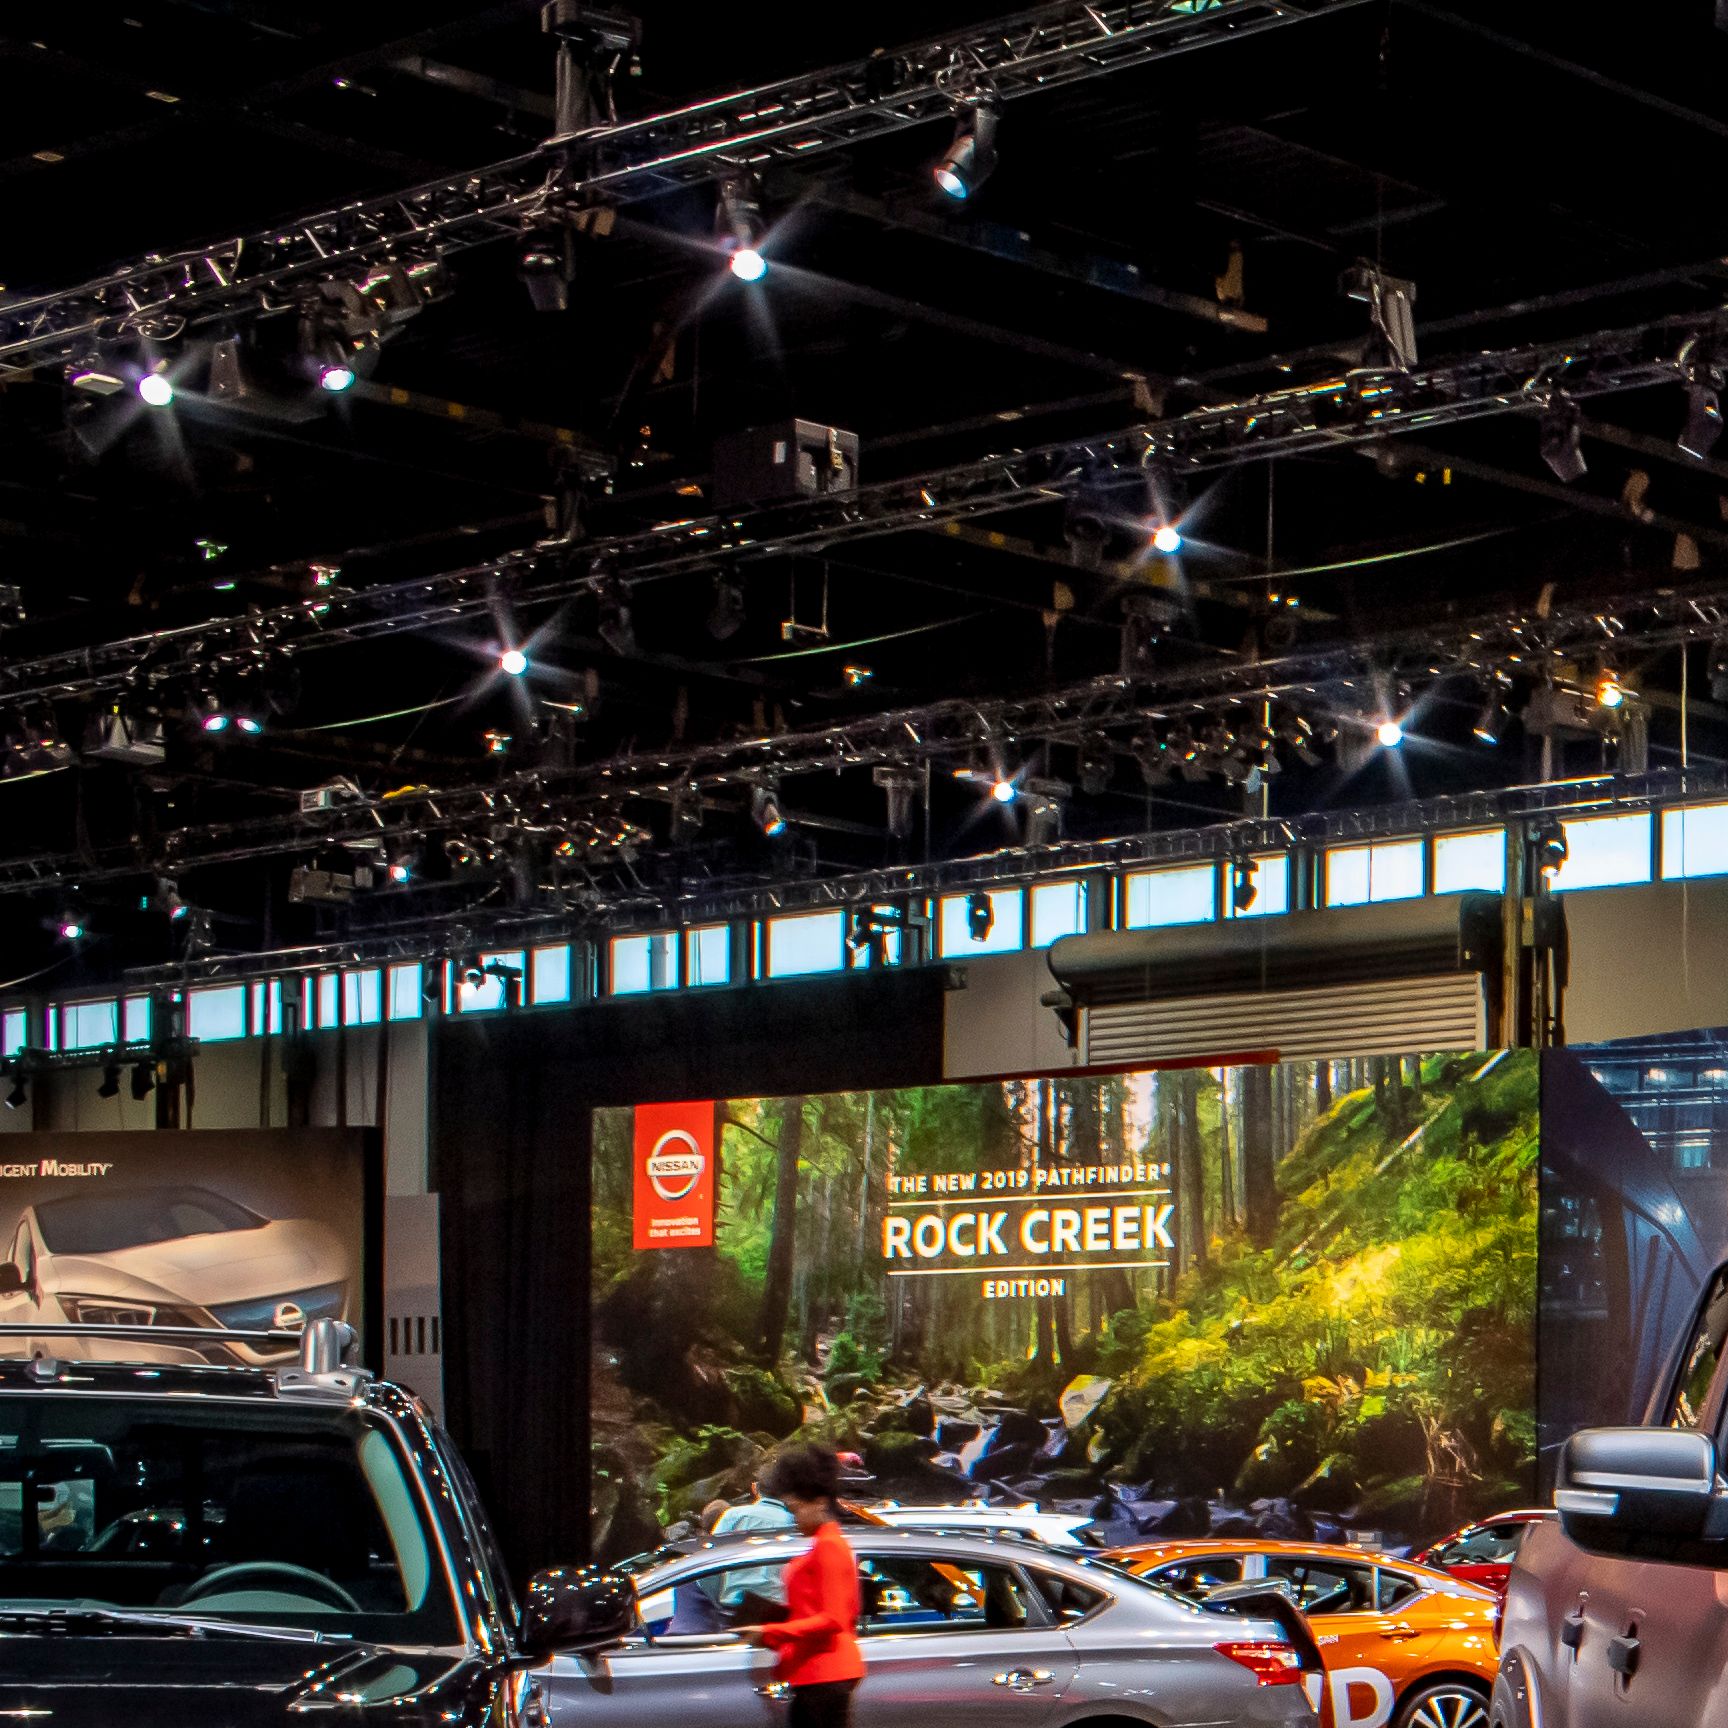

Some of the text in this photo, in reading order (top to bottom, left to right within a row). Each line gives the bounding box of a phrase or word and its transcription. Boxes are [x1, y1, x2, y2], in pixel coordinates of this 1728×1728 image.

[888, 1174, 927, 1193] THE
[933, 1171, 977, 1191] NEW
[981, 1168, 1029, 1190] 2019
[881, 1204, 1176, 1259] ROCK CREEK
[981, 1278, 1067, 1299] EDITION
